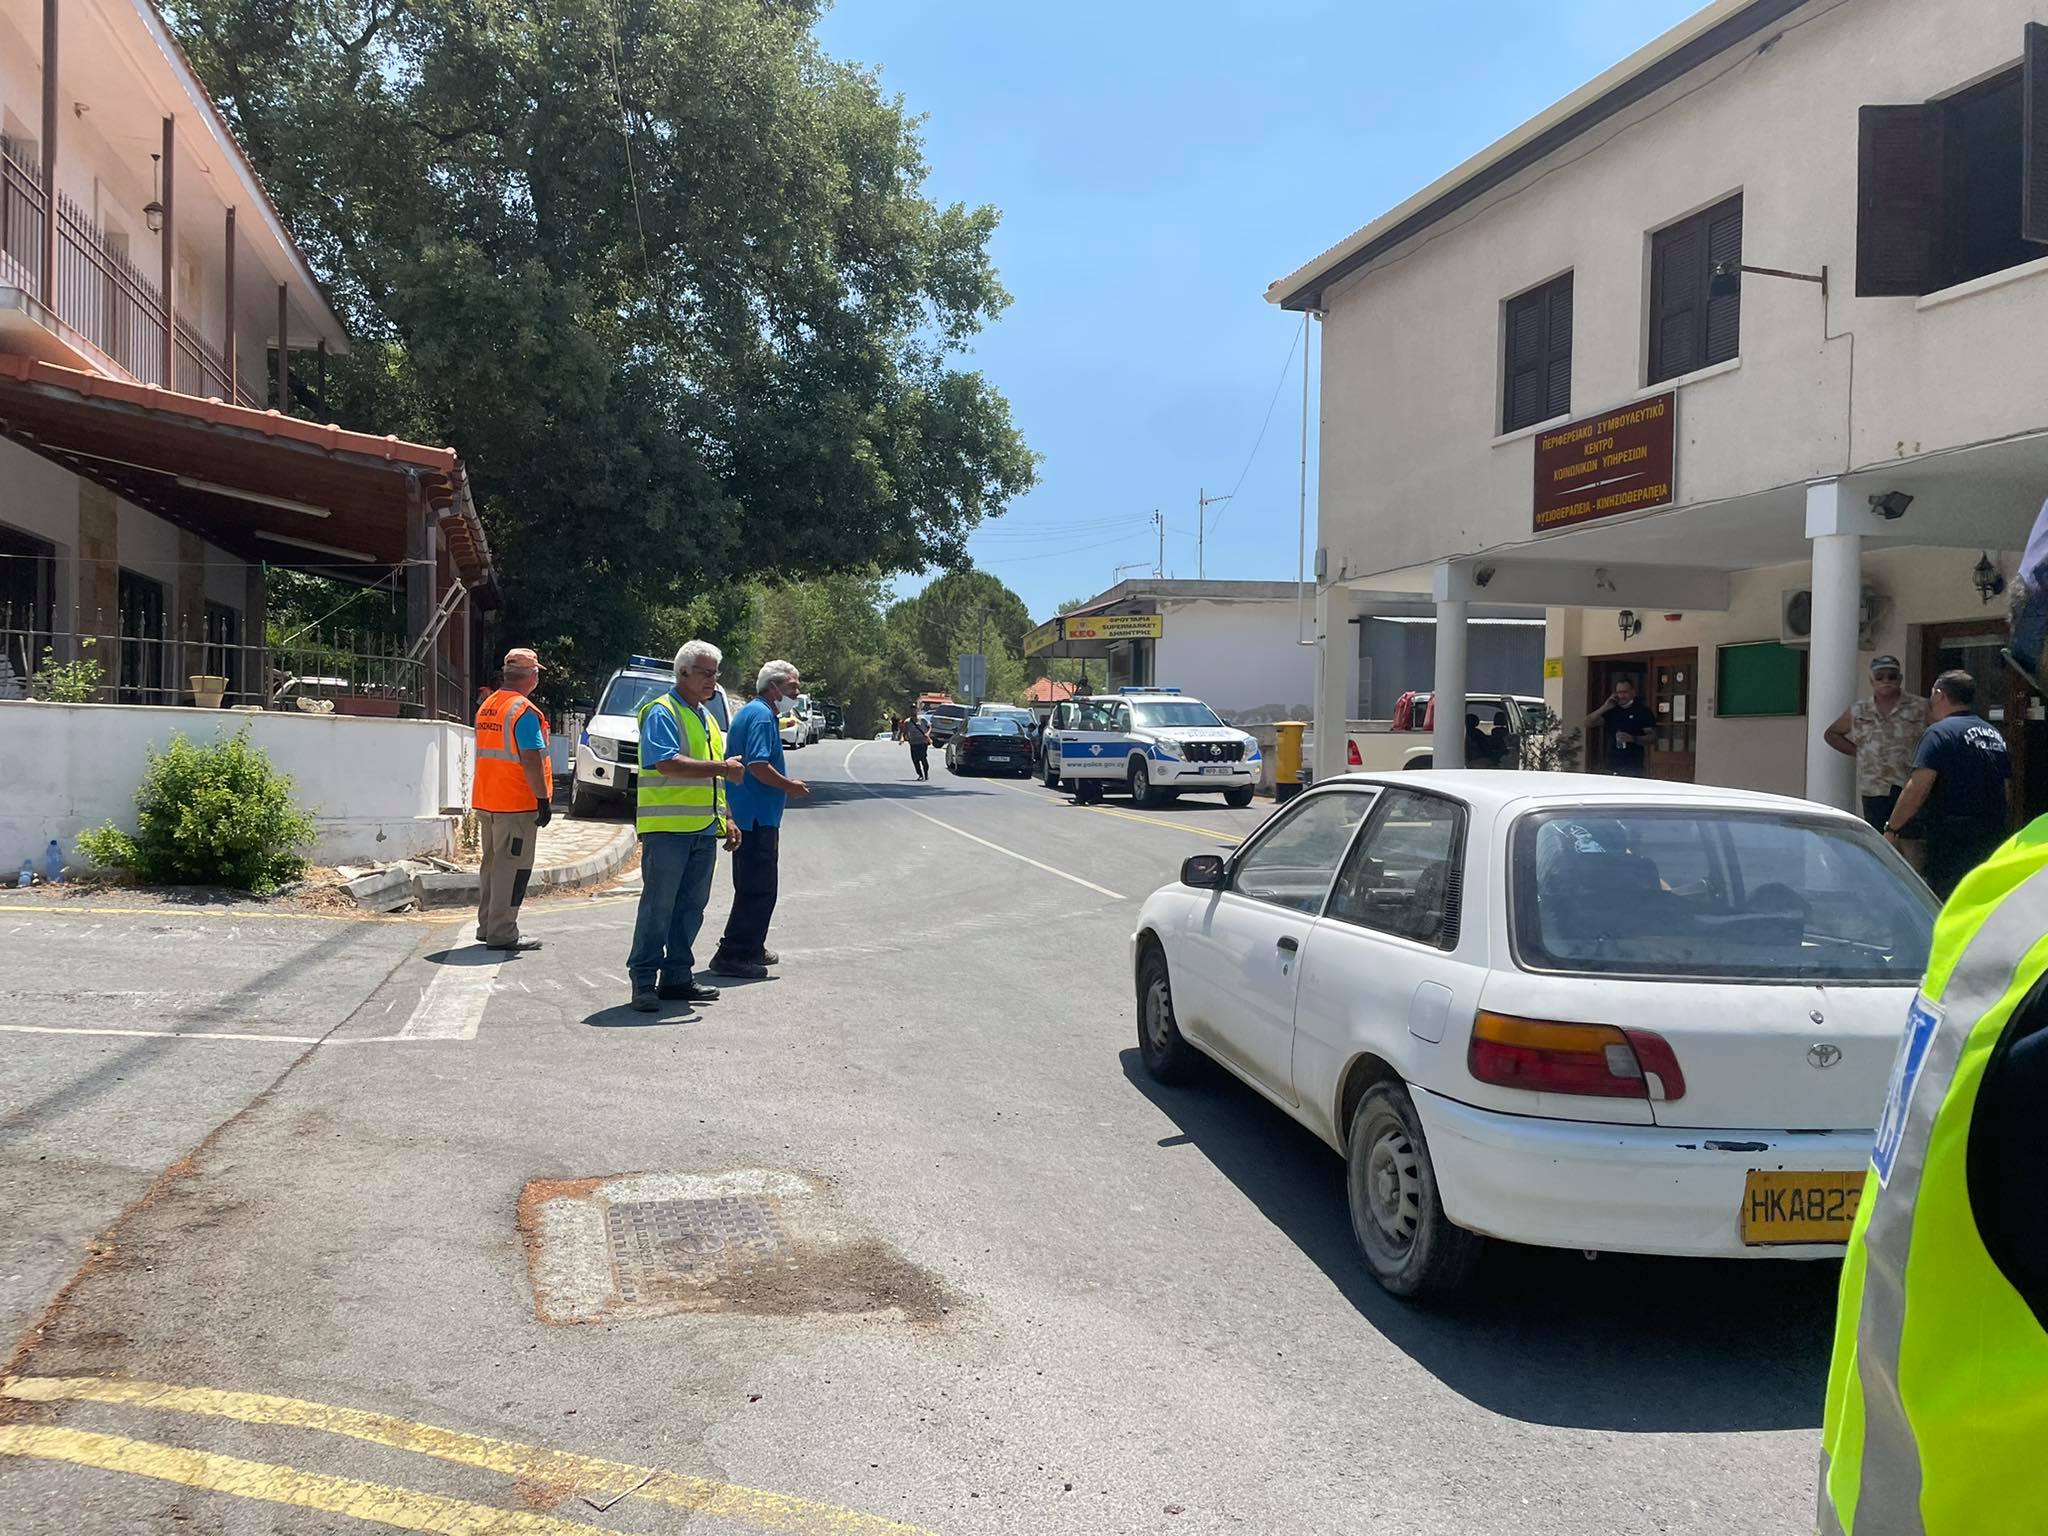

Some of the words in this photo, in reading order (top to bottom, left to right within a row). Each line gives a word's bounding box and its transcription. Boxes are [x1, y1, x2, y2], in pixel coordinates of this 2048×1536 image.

[1542, 425, 1593, 450] ΠΕΡΙΦΕΡΕΙΑΚΟ
[1597, 403, 1664, 434] ΣΥΜΒΟΥΛΕΥΤΙΚΟ
[1553, 459, 1598, 481] ΚΟΙΝΩΝΙΚΩΝ
[1602, 445, 1648, 468] ΥΠΗΡΕΣΙΩΝ
[1584, 437, 1614, 456] ΚΕΝΤΡΟ
[1535, 500, 1591, 524] ΦΥΣΙΟΘΕΡΑΠΕΙΑ
[1597, 484, 1667, 509] ΚΙΝΗΣΙΟΘΕΡΑΠΕΙΑ
[1069, 629, 1096, 638] KEO
